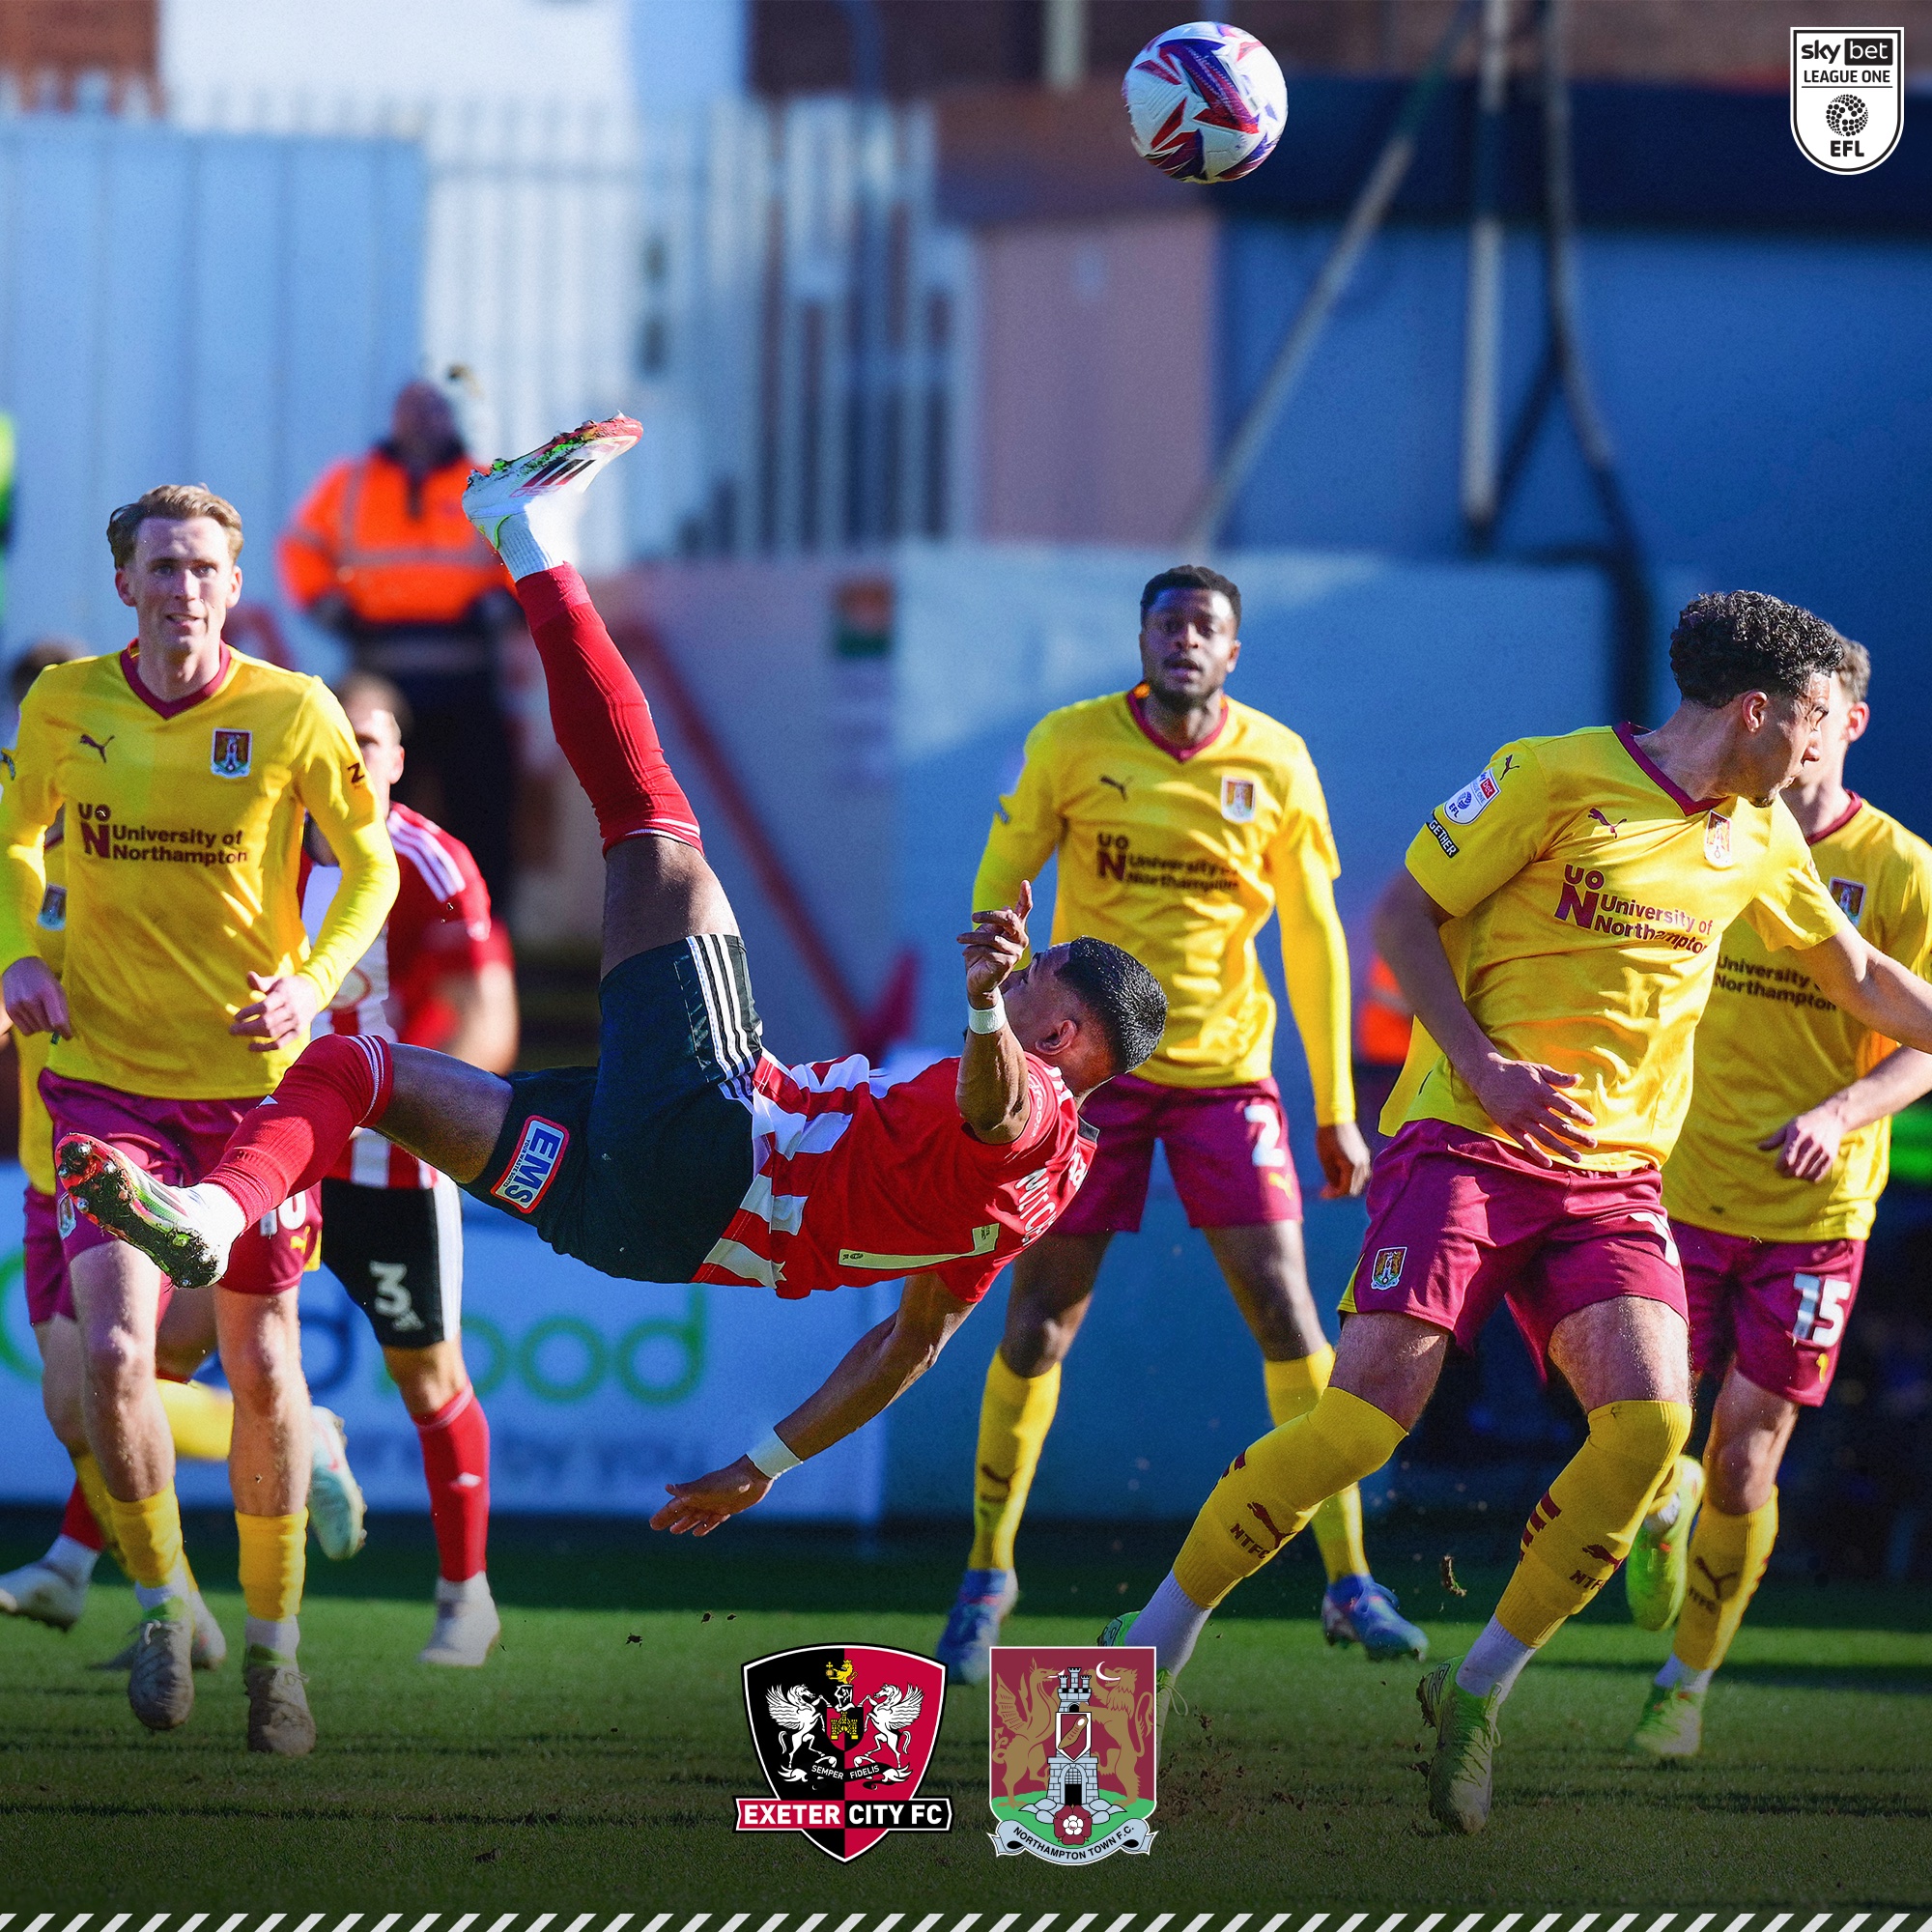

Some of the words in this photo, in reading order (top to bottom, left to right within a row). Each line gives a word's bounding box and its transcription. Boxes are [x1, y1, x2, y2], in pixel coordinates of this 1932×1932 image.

[1449, 802, 1460, 818] EFL
[112, 824, 217, 848] University
[222, 830, 243, 845] of
[112, 844, 248, 867] Northampton
[1554, 882, 1600, 930] N
[1600, 893, 1696, 933] University
[1698, 920, 1714, 936] of
[1243, 1104, 1286, 1167] 2
[503, 1127, 561, 1204] EMS
[369, 1261, 412, 1317] 3
[1793, 1272, 1852, 1348] 15
[1230, 1522, 1271, 1559] NTFC
